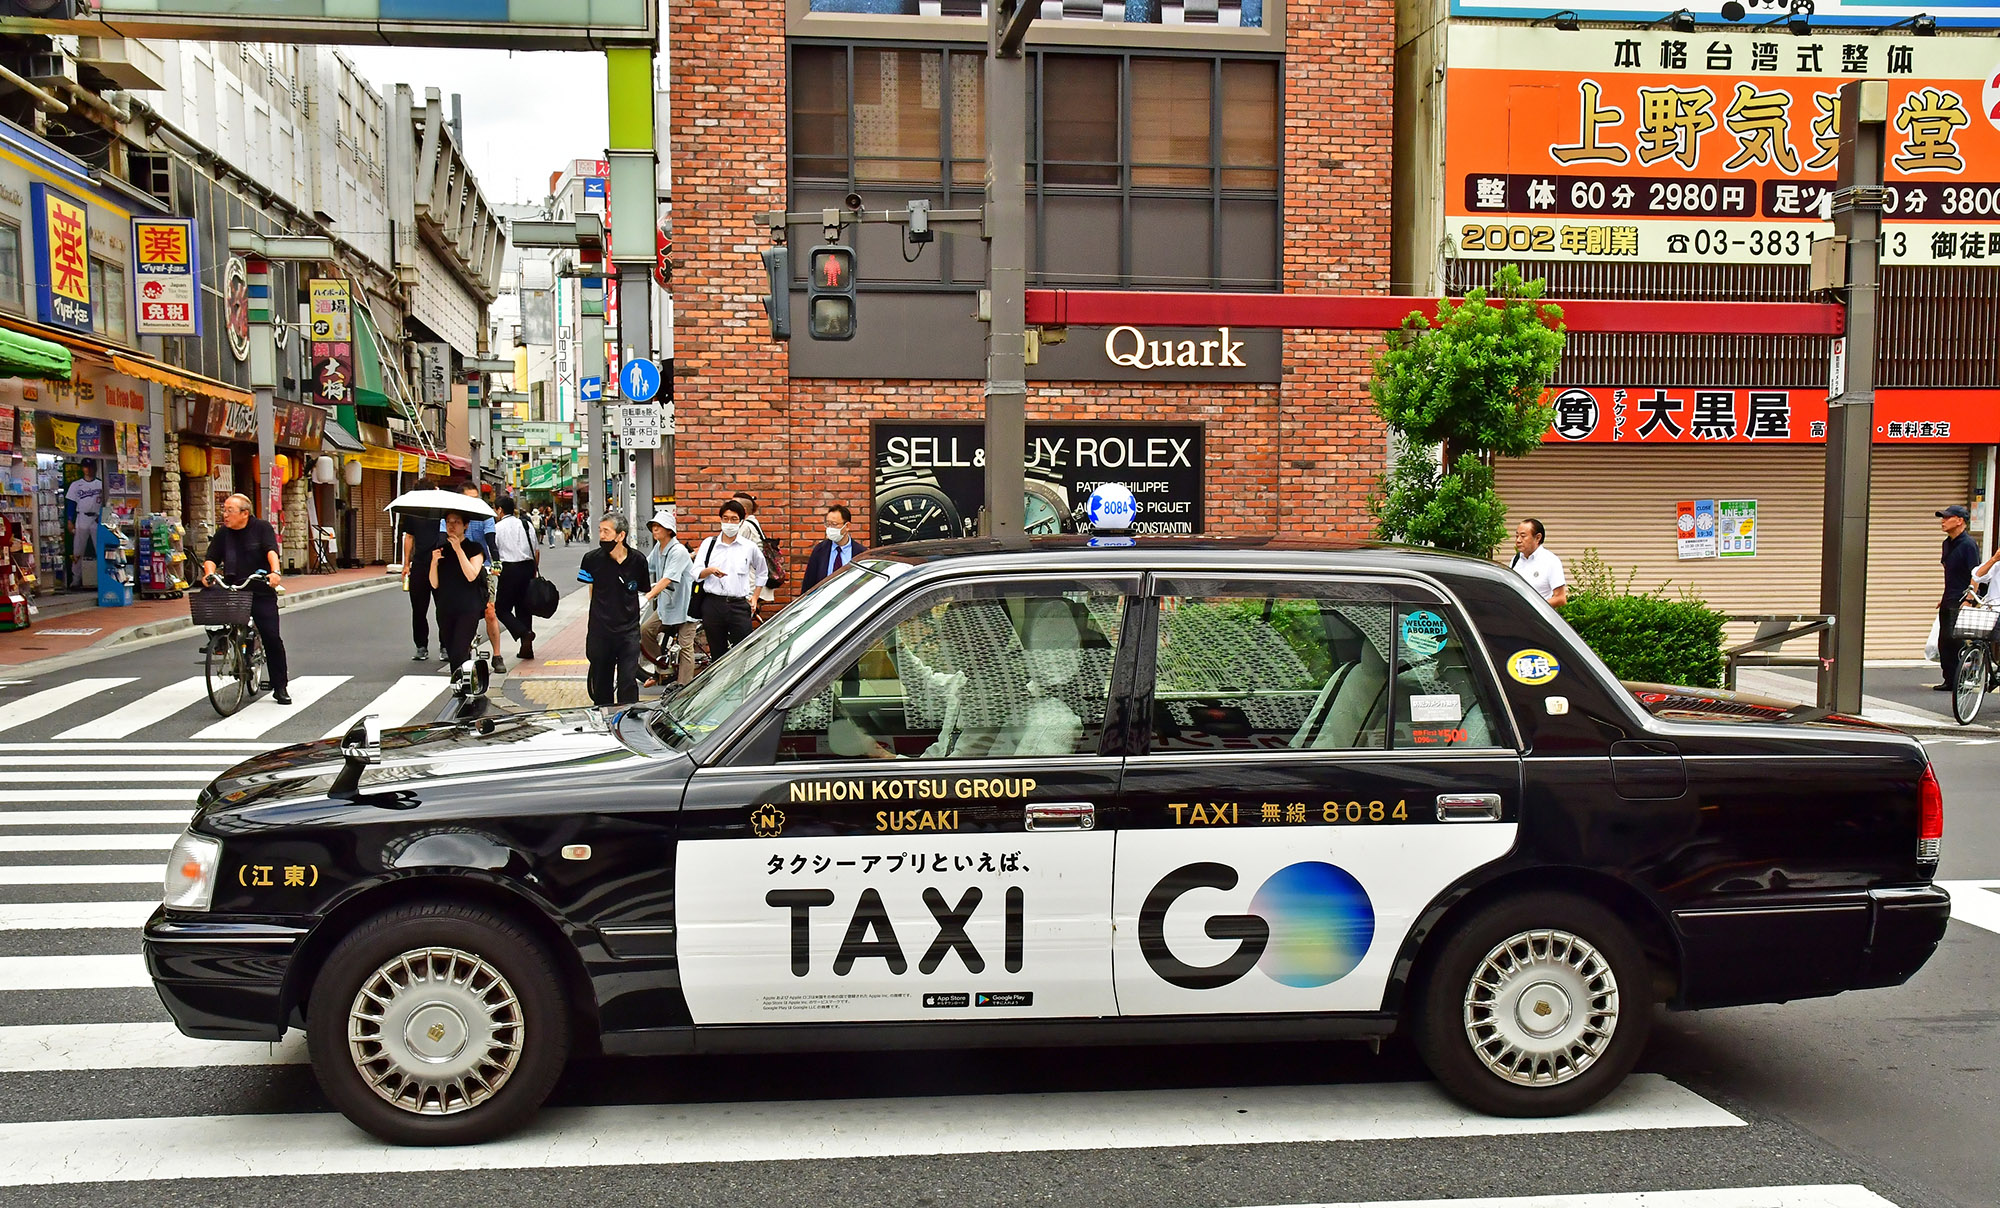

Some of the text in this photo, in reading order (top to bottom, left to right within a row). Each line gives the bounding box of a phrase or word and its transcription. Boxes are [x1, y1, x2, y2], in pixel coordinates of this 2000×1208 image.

[1614, 39, 1914, 74] 本格台湾式整体
[1476, 178, 1746, 212] 整体 60分 2980円
[52, 203, 85, 298] 薬
[144, 227, 182, 262] 薬
[1461, 225, 1639, 256] 2002年創業
[147, 303, 184, 320] 免税
[315, 322, 328, 334] 2F
[1105, 325, 1246, 370] Quark
[624, 417, 633, 427] 13
[650, 417, 657, 427] 6
[1613, 389, 1628, 440] チケット
[1637, 391, 1791, 440] 大黒屋
[624, 438, 633, 447] 12
[650, 438, 657, 447] 6
[886, 436, 970, 468] SELL
[1024, 437, 1066, 468] UY
[1076, 437, 1192, 468] ROLEX
[1103, 501, 1129, 515] 8084
[1147, 502, 1191, 513] PIGUET
[1515, 657, 1552, 678] 優良
[789, 778, 1037, 802] NIHON KOTSU GROUP
[876, 810, 959, 832] SUSAKI
[1168, 800, 1409, 825] TAXI 無線 8084
[766, 851, 1031, 875] タクシーアプリといえば、
[765, 886, 1024, 977] TAXI
[1138, 861, 1375, 989] GO
